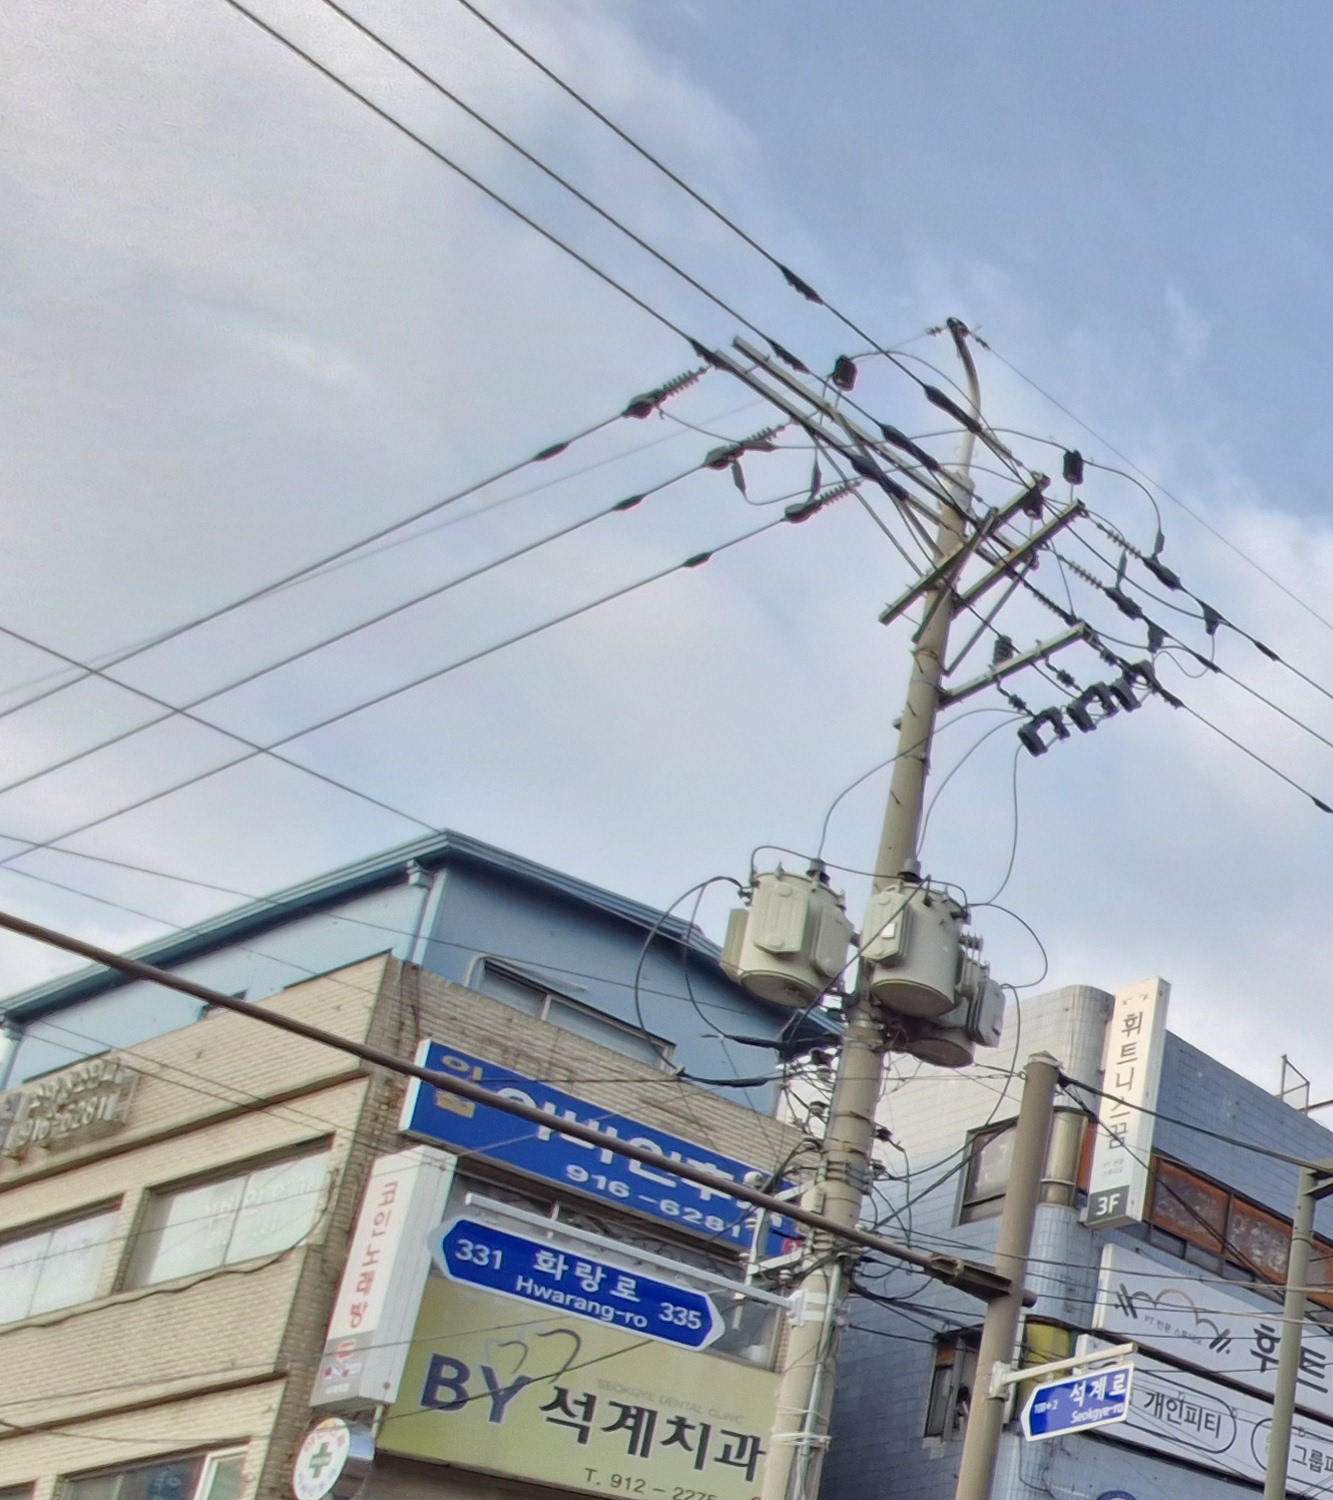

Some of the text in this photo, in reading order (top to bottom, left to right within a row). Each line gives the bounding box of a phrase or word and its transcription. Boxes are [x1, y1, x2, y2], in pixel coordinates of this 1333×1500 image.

[1108, 1010, 1144, 1151] 휘트니스꿈
[1096, 1193, 1121, 1216] 3F
[454, 1238, 503, 1271] 331
[533, 1249, 641, 1303] 화랑로
[515, 1275, 649, 1329] Hwarang-ro
[658, 1302, 703, 1331] 335
[419, 1352, 535, 1424] BY
[1069, 1374, 1127, 1408] 석계로
[538, 1385, 768, 1483] 석계치과
[1070, 1402, 1125, 1425] Seokgye-ro
[1143, 1390, 1223, 1440] 개인피티
